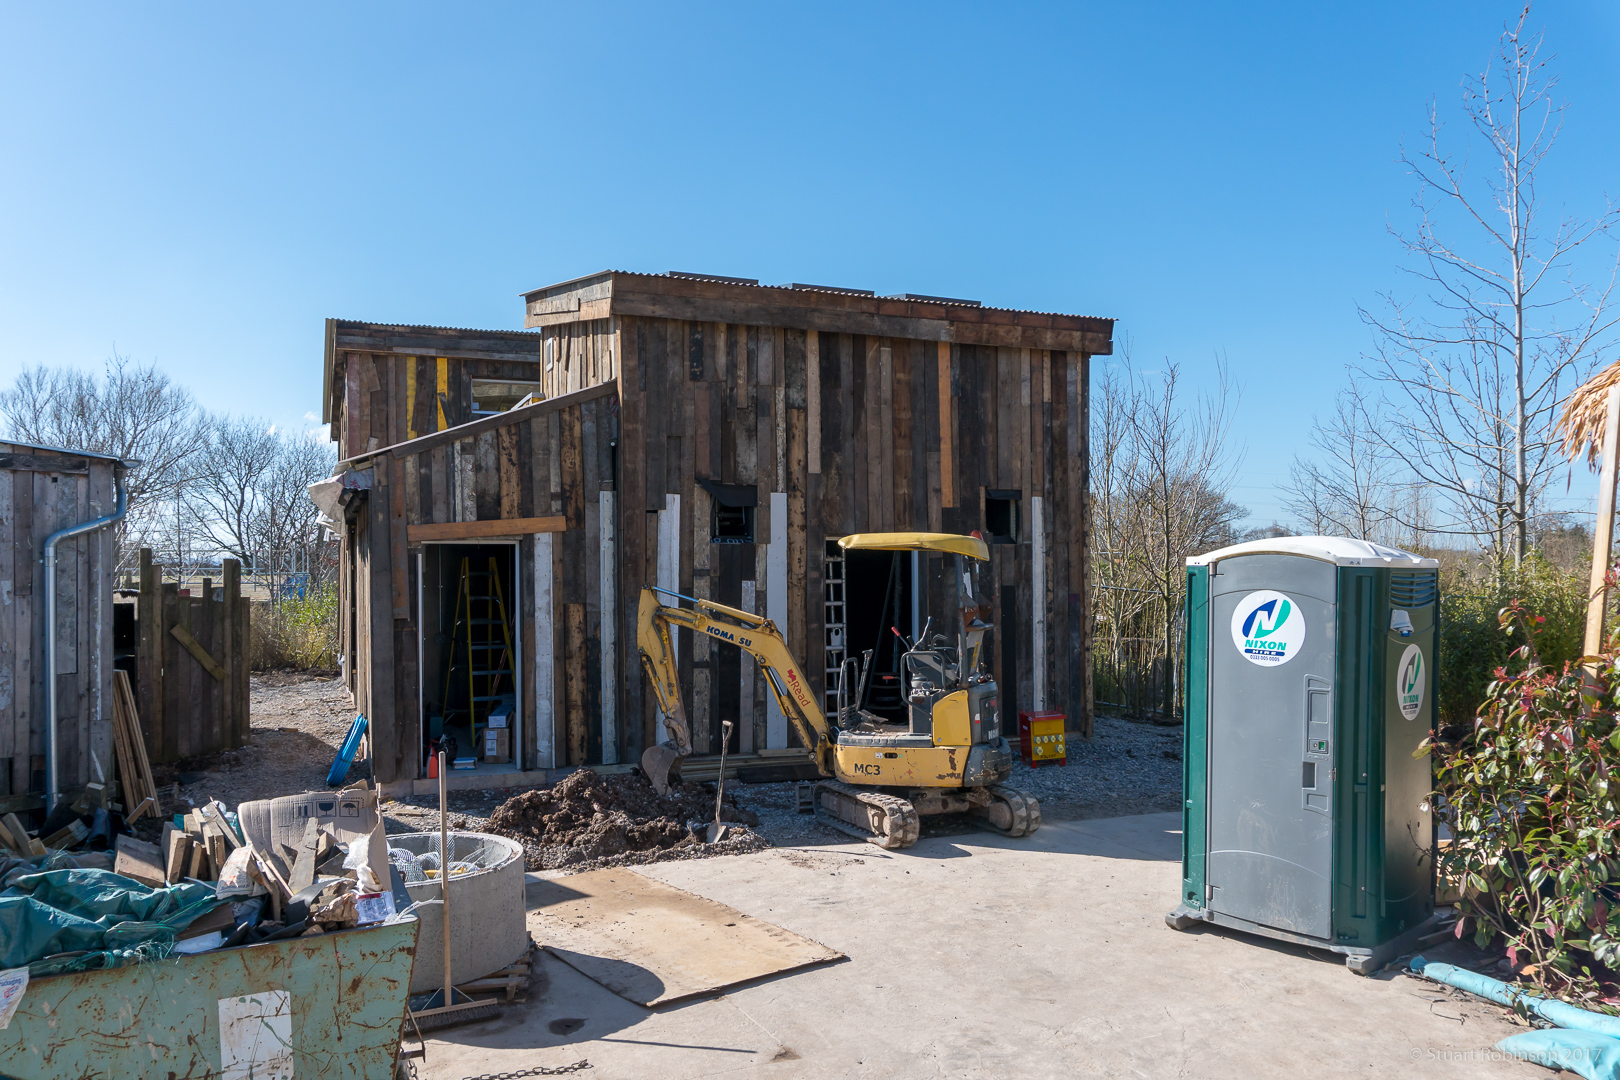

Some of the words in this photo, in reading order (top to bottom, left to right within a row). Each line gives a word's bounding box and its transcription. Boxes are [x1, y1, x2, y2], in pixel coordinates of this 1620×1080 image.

[706, 625, 752, 647] KOMASU
[1244, 639, 1287, 651] NIXON
[790, 680, 811, 707] Read
[1403, 694, 1420, 704] NIXON
[854, 763, 881, 776] MC3
